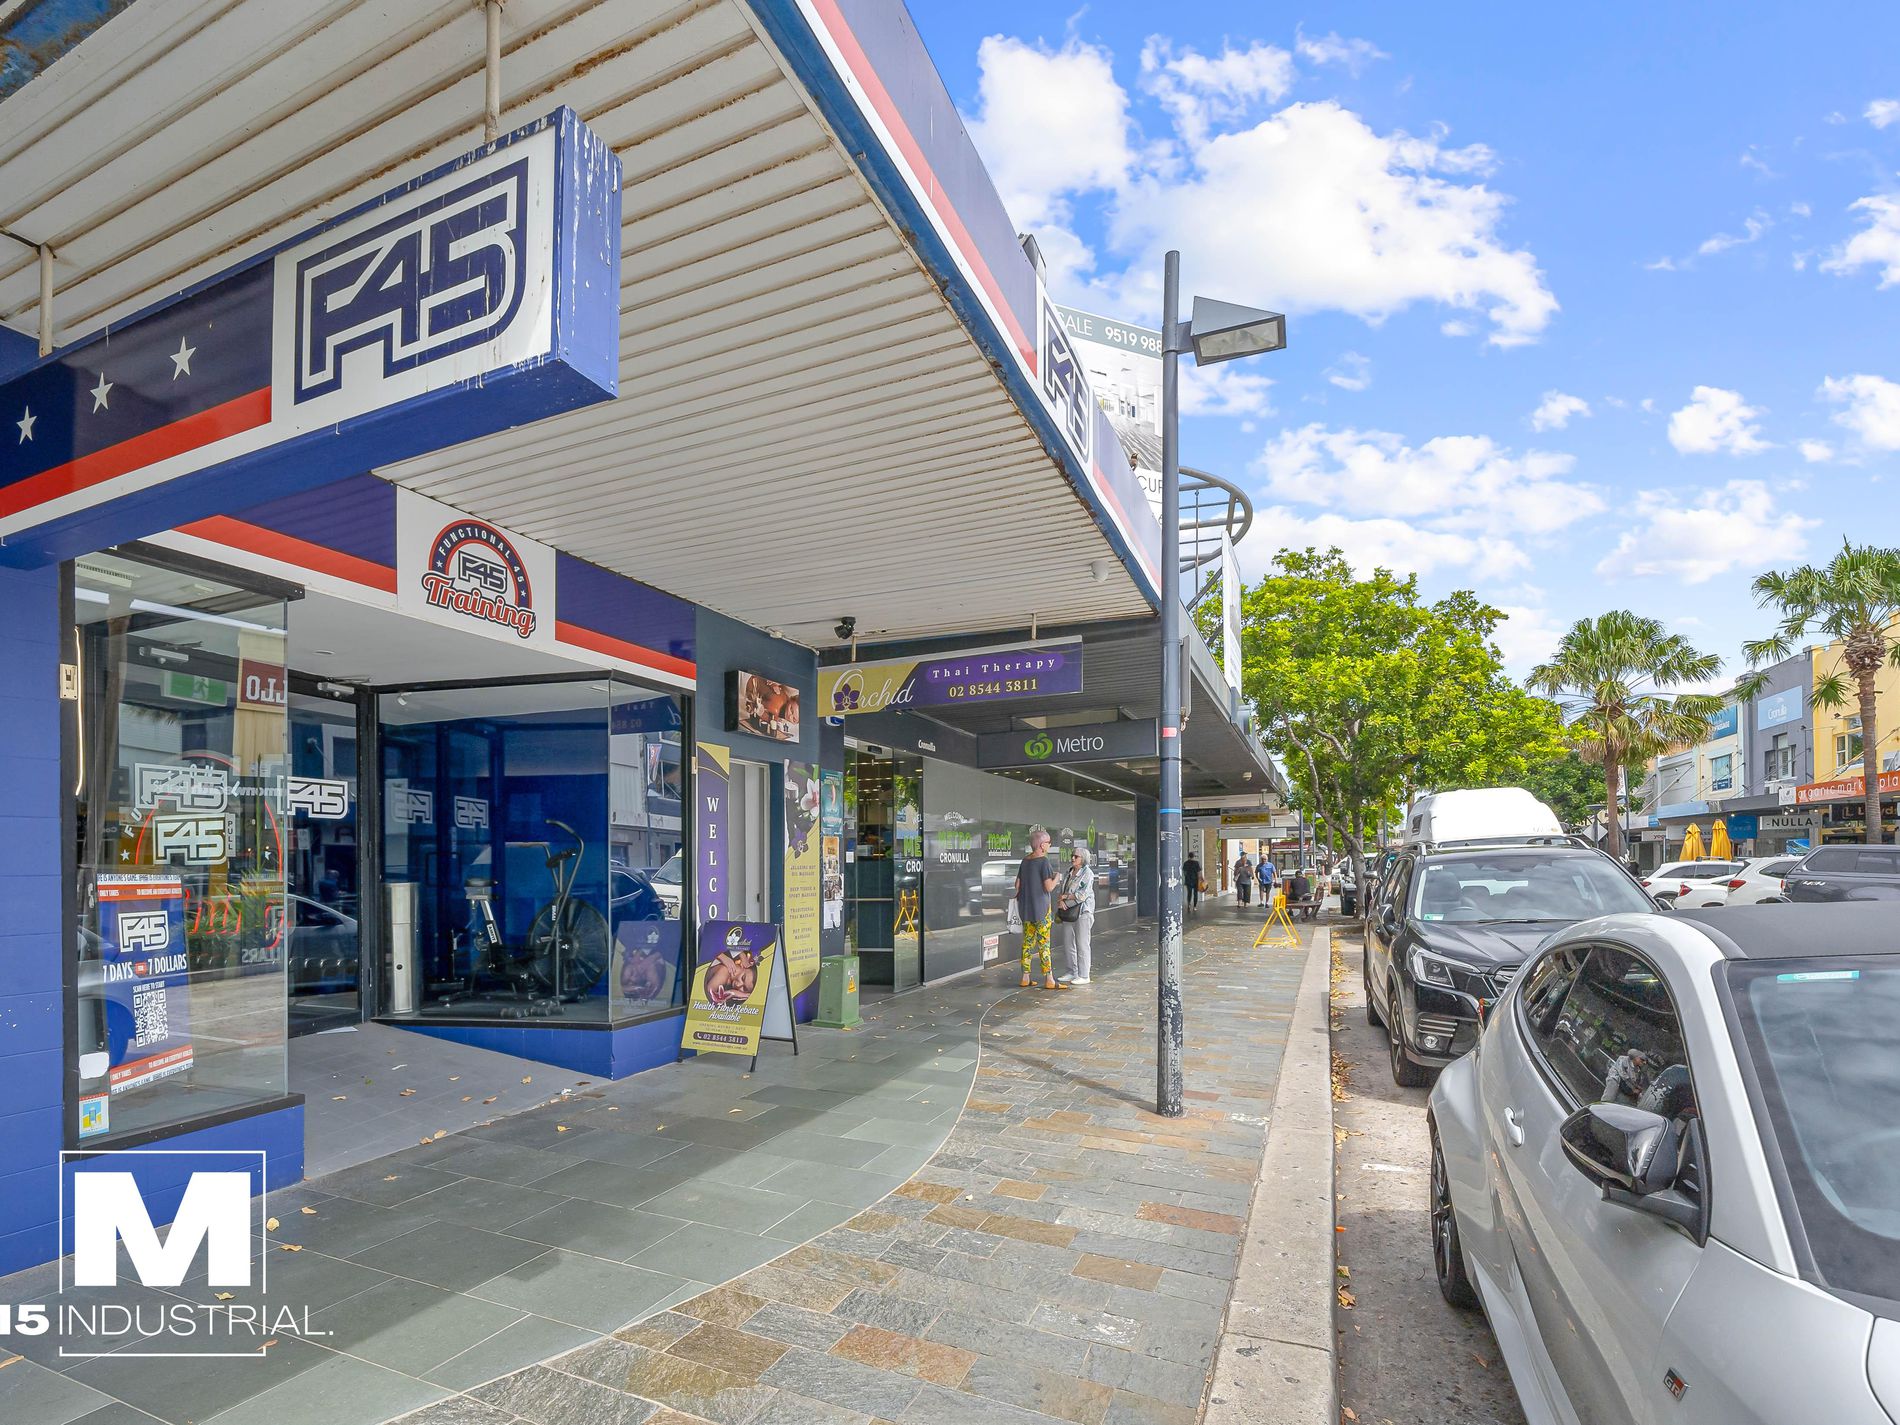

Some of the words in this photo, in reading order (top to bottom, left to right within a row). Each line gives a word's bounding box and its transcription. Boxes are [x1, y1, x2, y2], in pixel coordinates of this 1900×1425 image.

[290, 156, 530, 406] F45
[1104, 326, 1137, 346] 9519
[1043, 295, 1090, 464] F45
[438, 527, 511, 558] FUNCTIONAL
[513, 565, 525, 583] 45
[458, 550, 507, 593] F45
[422, 572, 537, 639] Training
[932, 666, 970, 679] Thai
[981, 657, 1056, 675] Therapy
[831, 668, 917, 712] Orchid
[949, 686, 965, 698] 02
[969, 682, 1001, 696] 8544
[1006, 678, 1038, 692] 3811
[1056, 736, 1104, 754] Metro
[135, 763, 227, 814] F45
[277, 775, 349, 820] F45
[152, 812, 227, 866] F45
[227, 820, 235, 850] PULL
[938, 831, 973, 851] METRO
[706, 797, 720, 919] WELCO
[939, 852, 970, 863] CRONULLA
[118, 911, 170, 953] F45
[103, 965, 108, 982] 7
[110, 961, 133, 982] DAYS
[148, 959, 152, 975] 7
[155, 954, 187, 974] DOLLARS
[692, 1000, 715, 1011] Health
[715, 1004, 734, 1014] Fund
[734, 1004, 760, 1015] Rebate
[709, 1012, 741, 1022] Available
[1663, 1375, 1681, 1399] GR
